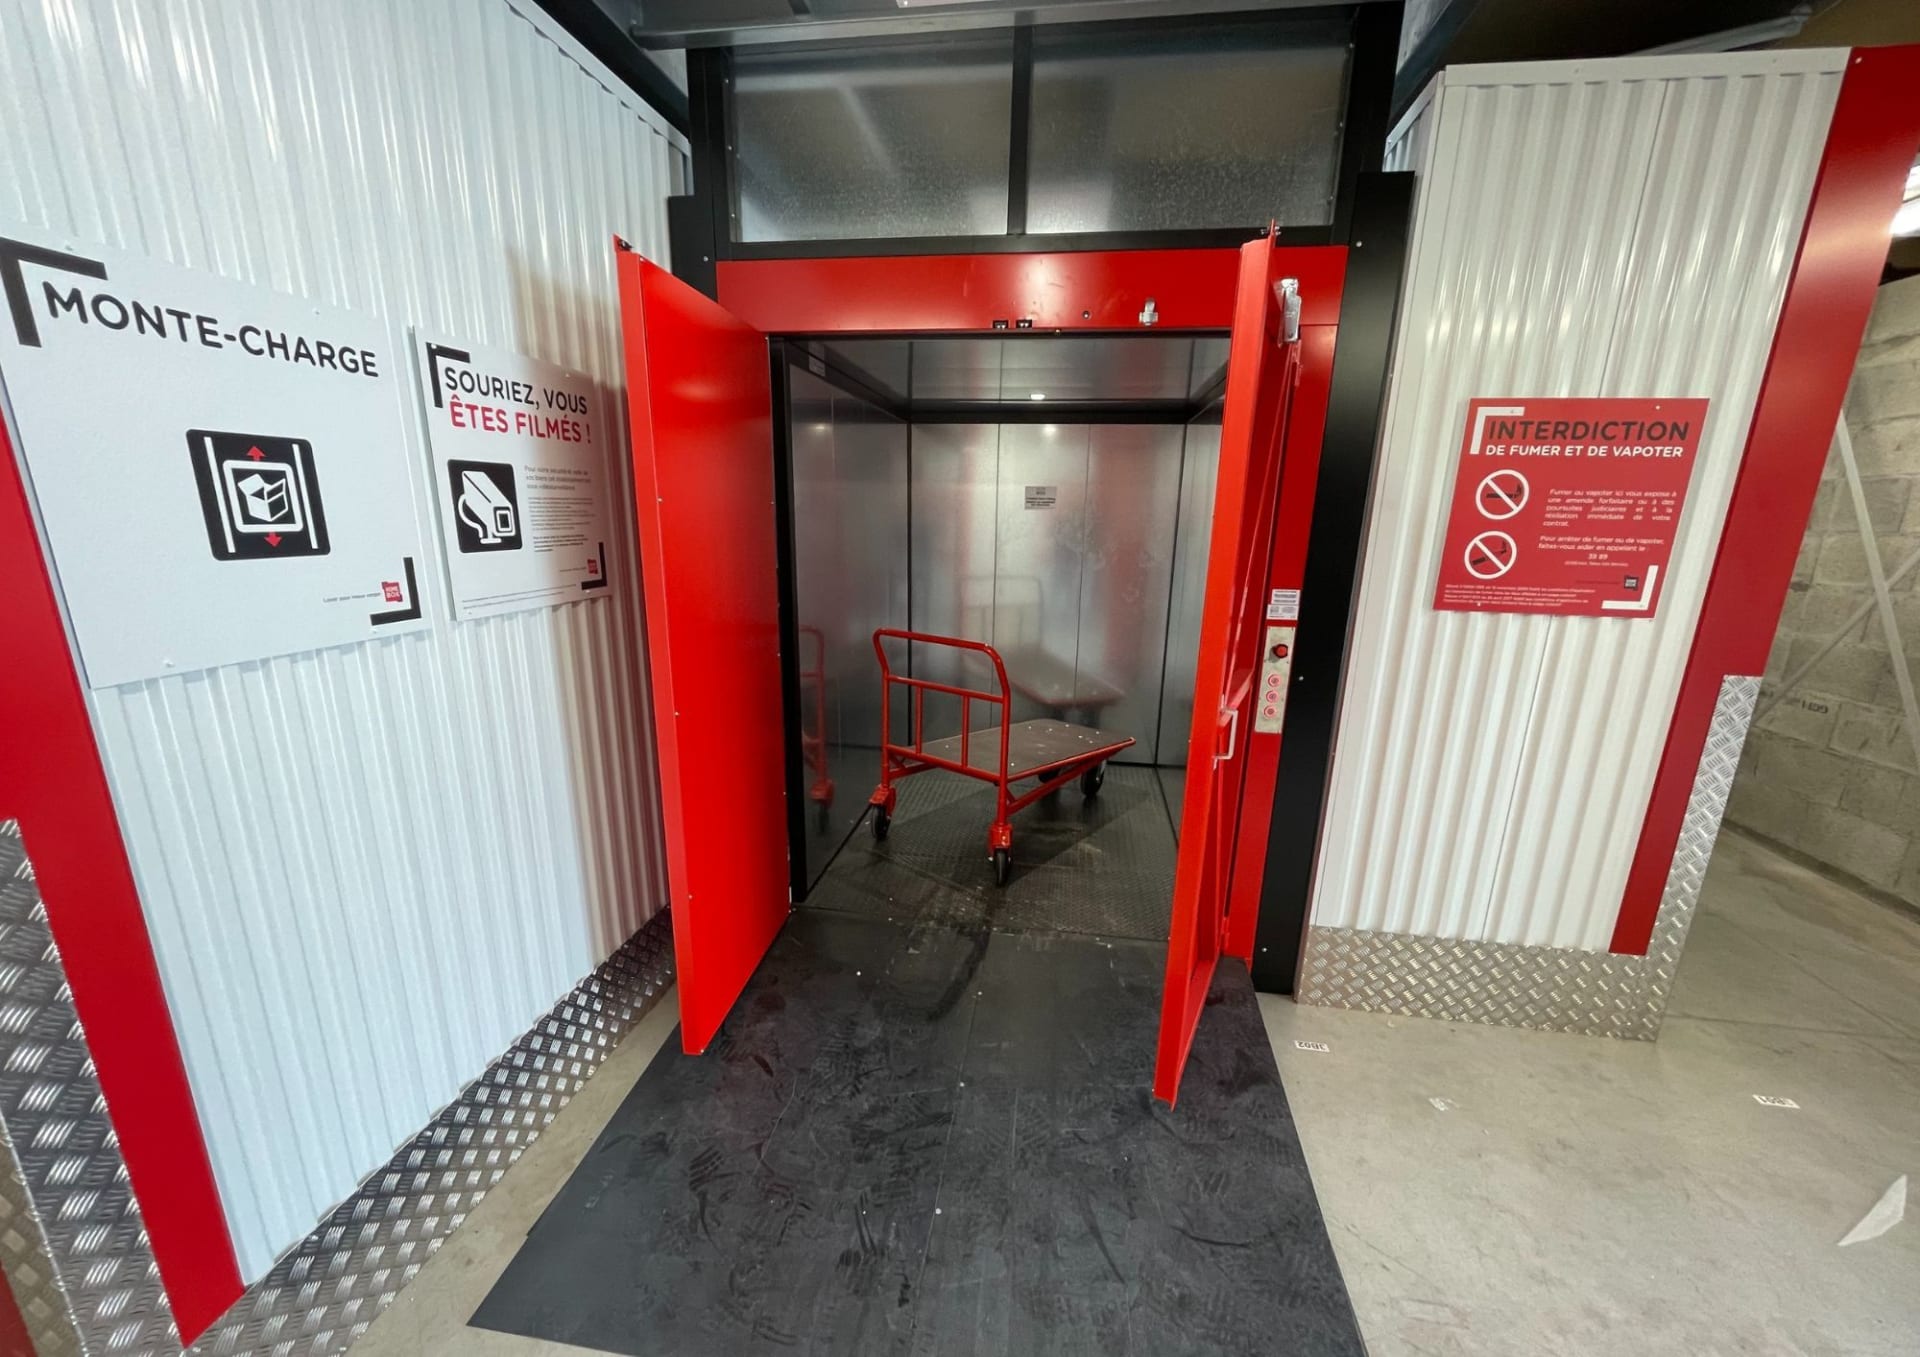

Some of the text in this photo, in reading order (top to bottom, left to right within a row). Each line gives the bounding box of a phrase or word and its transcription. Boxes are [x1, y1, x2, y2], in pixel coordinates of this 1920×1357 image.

[42, 281, 379, 377] MONTE-CHARGE
[444, 366, 588, 415] SOURIEZ, VOUS
[450, 394, 508, 433] ÊTES
[515, 415, 582, 443] FILMÉS
[1488, 420, 1690, 441] INTERDICTION
[1486, 445, 1684, 457] DE FUMER ET DE VAPOTER
[1586, 490, 1613, 498] vapoter
